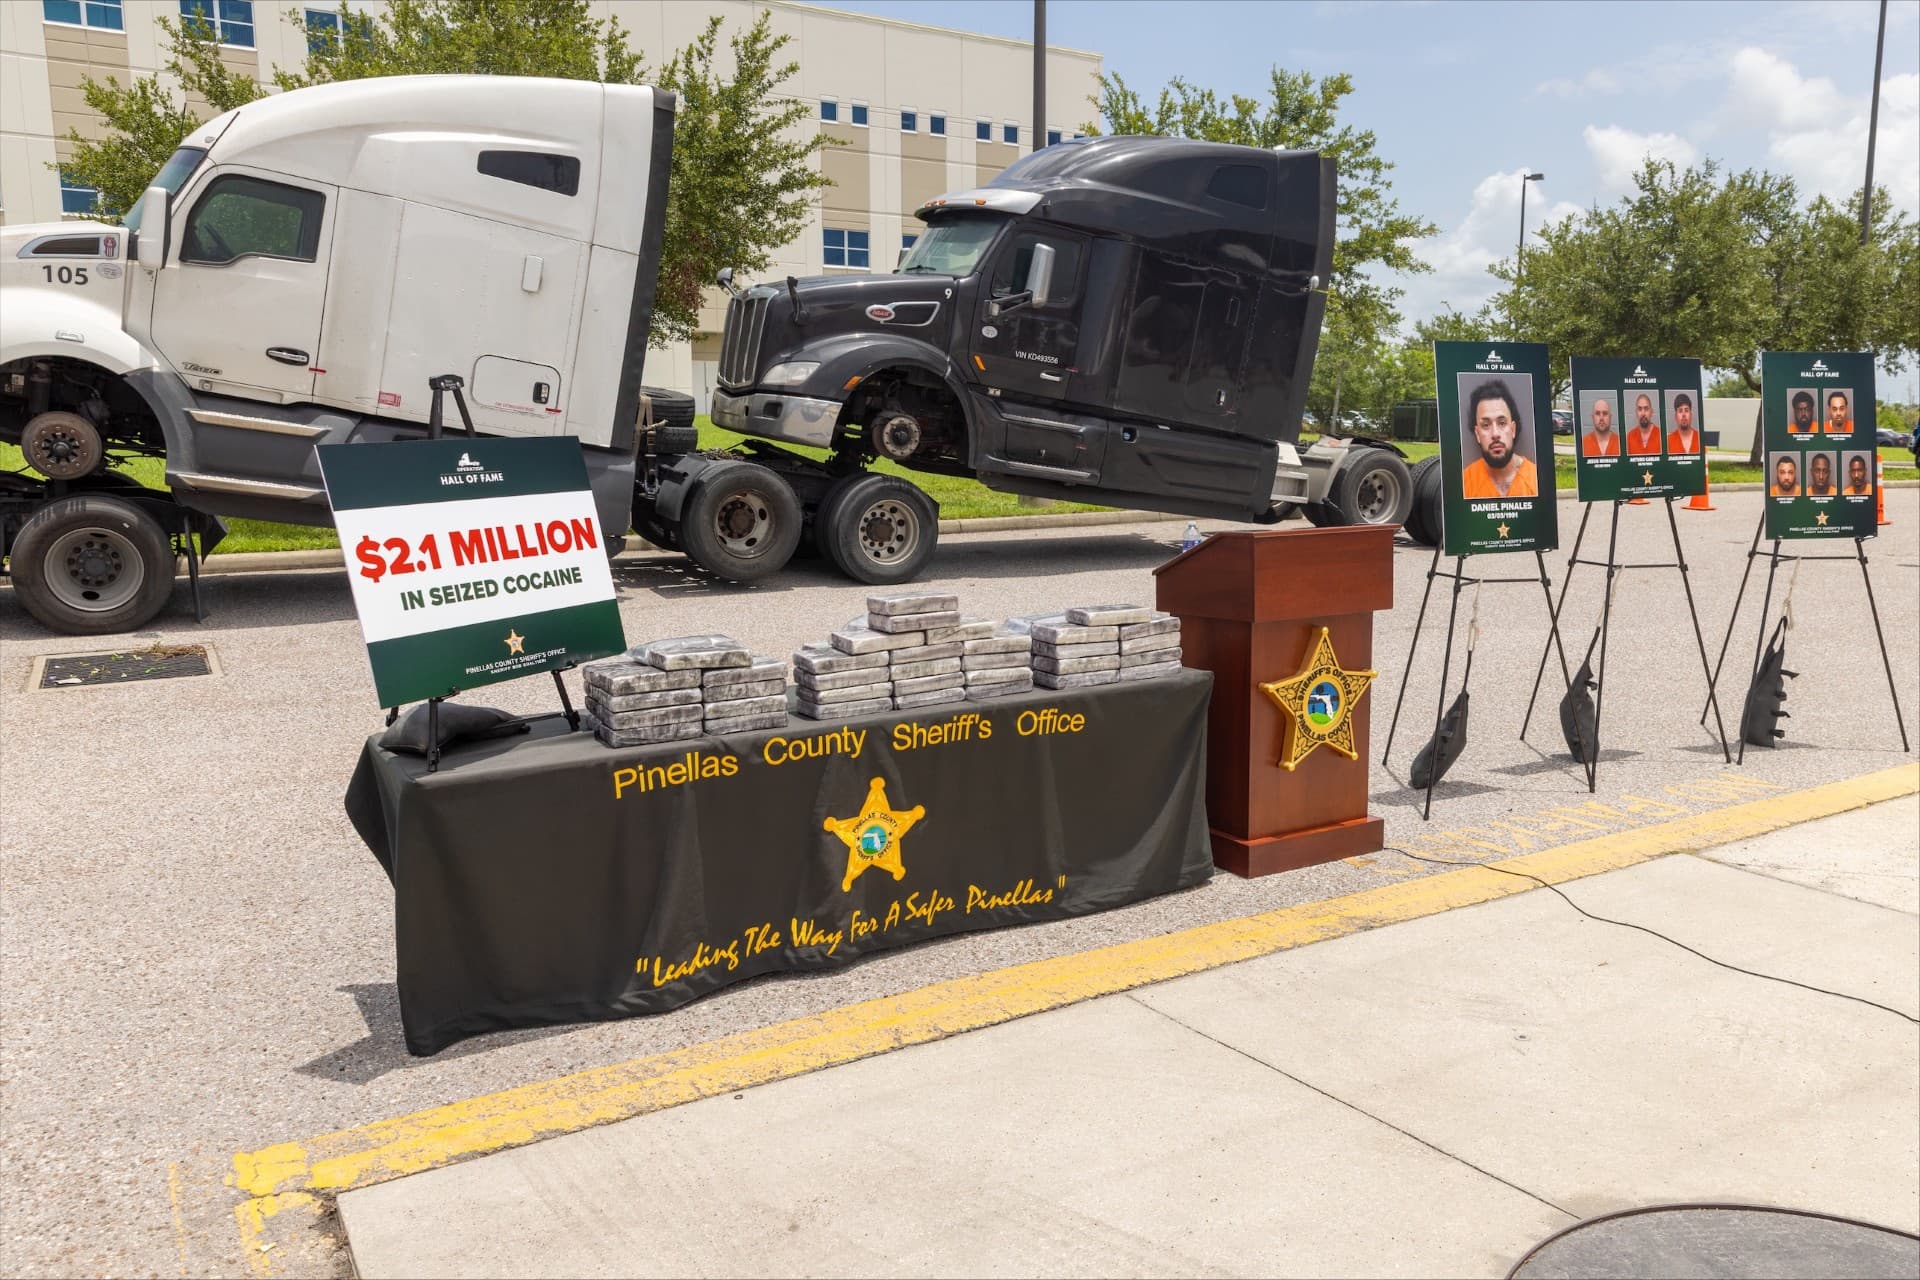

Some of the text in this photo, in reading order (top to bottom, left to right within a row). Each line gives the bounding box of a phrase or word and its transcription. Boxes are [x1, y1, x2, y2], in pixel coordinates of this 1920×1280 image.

[42, 264, 89, 285] 105
[944, 288, 953, 299] 9
[1015, 350, 1027, 360] VIN
[440, 473, 504, 485] HALL OF FAME
[1471, 502, 1533, 512] DANIEL PINALES
[355, 517, 598, 583] $2.1 MILLION
[400, 566, 583, 611] IN SEIZED COCAINE
[465, 647, 567, 675] PINELLAS COUNTY SHERIFF'S OFFICE
[1297, 666, 1353, 701] SHERIFF'S OFFICE
[1297, 707, 1351, 741] PINELLAS COUNTY
[613, 708, 1086, 800] Pinellas County Sheriff's Office
[879, 812, 898, 828] COUNTY
[744, 922, 782, 958] The
[791, 917, 844, 956] Way
[850, 909, 879, 943] For
[883, 900, 900, 932] A
[904, 888, 956, 926] Safer
